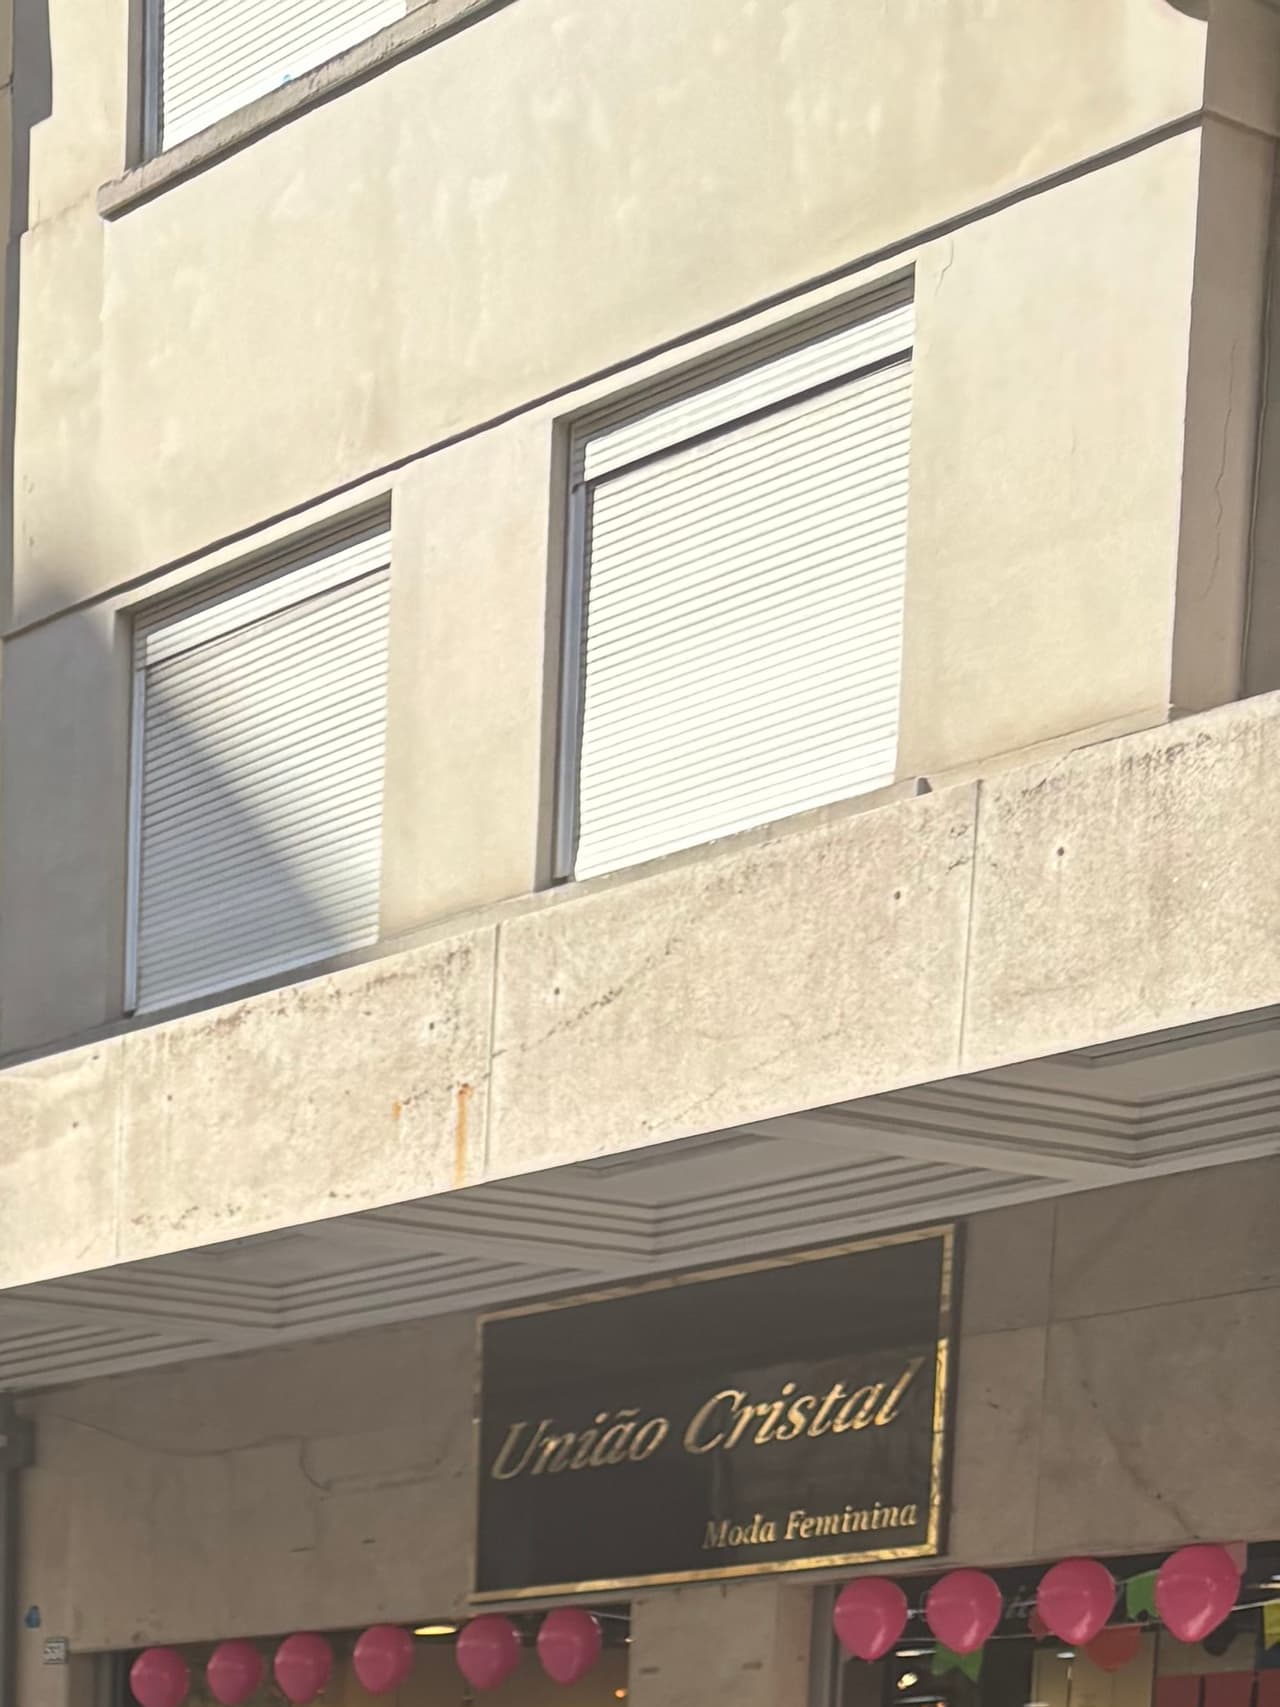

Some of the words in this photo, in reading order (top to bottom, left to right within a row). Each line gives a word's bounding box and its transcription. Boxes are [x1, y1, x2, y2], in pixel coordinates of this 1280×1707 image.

[490, 1407, 671, 1481] União
[683, 1356, 927, 1456] Cristal
[701, 1512, 777, 1551] Moda
[784, 1499, 919, 1542] Feminina
